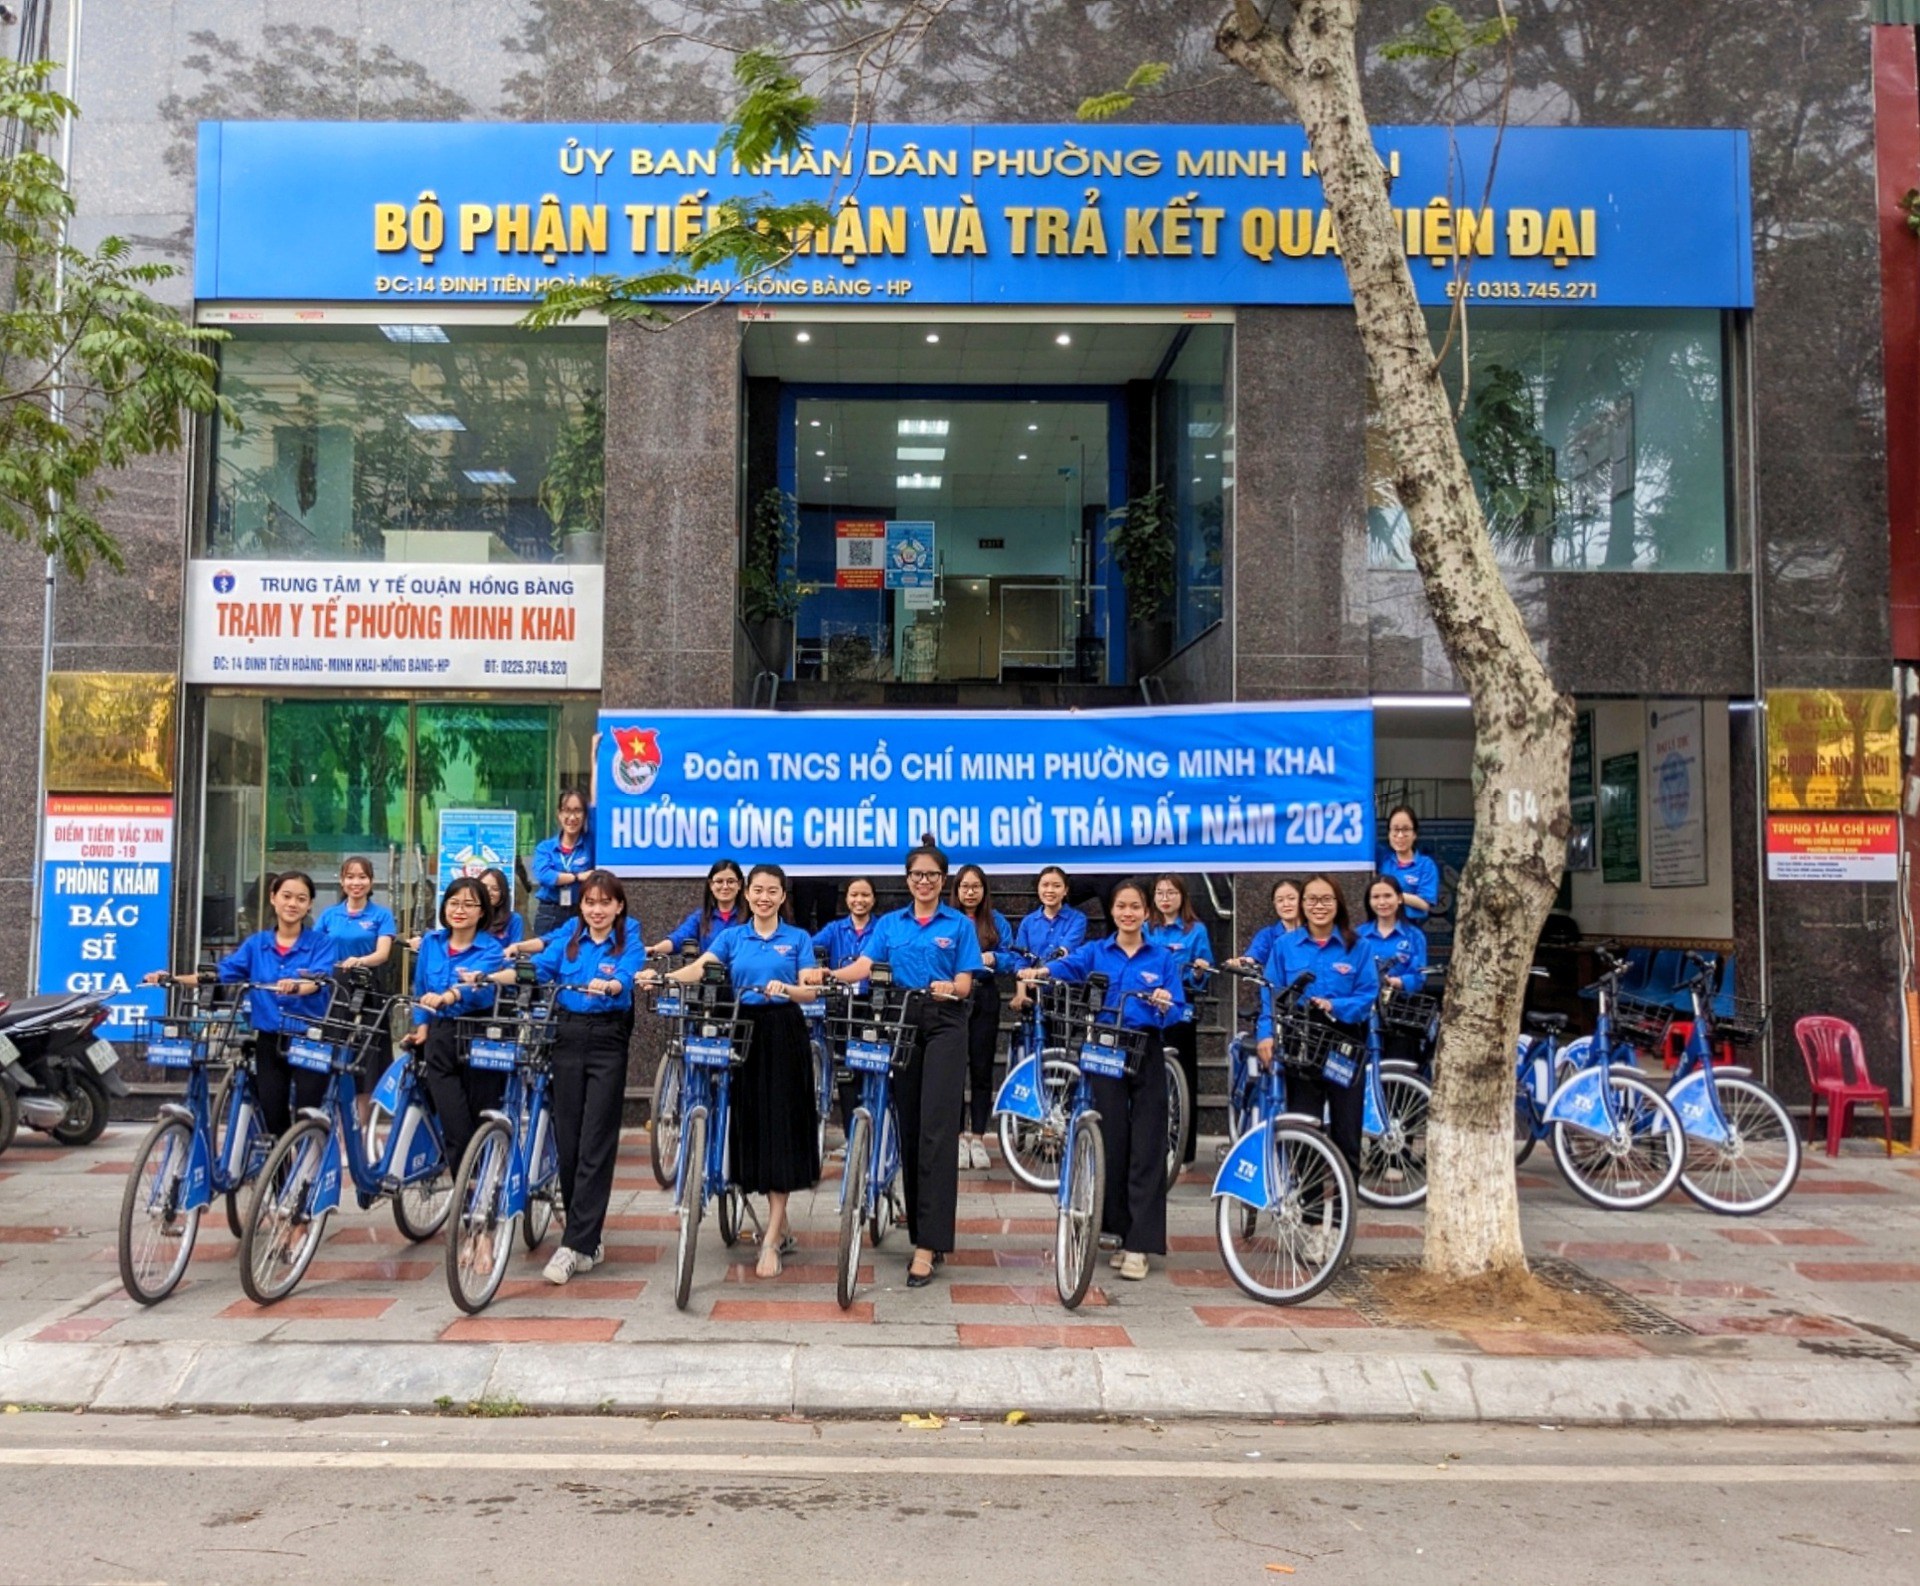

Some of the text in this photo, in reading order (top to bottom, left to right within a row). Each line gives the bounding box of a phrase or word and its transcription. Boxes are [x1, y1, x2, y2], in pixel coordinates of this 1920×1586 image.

[559, 137, 614, 176] ỦY
[630, 149, 717, 176] BAN
[867, 142, 958, 177] DÂN
[972, 140, 1162, 177] PHƯỜNG
[1177, 150, 1287, 178] MINH
[1302, 150, 1399, 178] KI
[374, 190, 444, 264] BỘ
[459, 193, 608, 265] PHẬN
[757, 195, 907, 266] HẬN
[923, 193, 988, 255] VÀ
[1004, 187, 1108, 255] TRẢ
[1125, 191, 1226, 256] KẾT
[1392, 196, 1495, 268] IỆN
[1507, 208, 1597, 268] ĐẠI
[491, 273, 531, 293] TIÊN
[811, 274, 872, 295] BÀNG
[887, 280, 912, 295] HP
[1477, 281, 1597, 299] 0313.745.271
[261, 574, 574, 598] TRUNG TÂM Y TẾ QUẬN HỒNG BÀNG
[216, 595, 576, 644] TRẠM Y TẾ PHƯỜNG MINH KHAI
[683, 738, 1336, 781] Đoàn TNCS HỒ CHÍ MINH PHƯỜNG MINH KHAI
[612, 794, 720, 849] HƯỞNG
[729, 798, 794, 848] ỨNG
[804, 794, 898, 848] CHIẾN
[990, 796, 1043, 848] GIỜ
[1051, 796, 1122, 847] TRÁI
[1131, 790, 1191, 846] ĐẤT
[1201, 795, 1275, 845] NĂM
[1285, 802, 1363, 845] 2023
[1508, 788, 1539, 823] 64
[54, 820, 84, 843] ĐIỂM
[87, 823, 115, 843] TIÊM
[143, 827, 165, 843] XIN
[1772, 822, 1811, 835] TRUNG
[1814, 820, 1840, 835] TÂM
[1867, 823, 1892, 836] HUY
[81, 844, 114, 858] COVID
[55, 861, 161, 896] PHÒNG KHÁM
[68, 898, 140, 928] BÁC
[81, 933, 117, 960] SĨ
[66, 972, 132, 995] GIA
